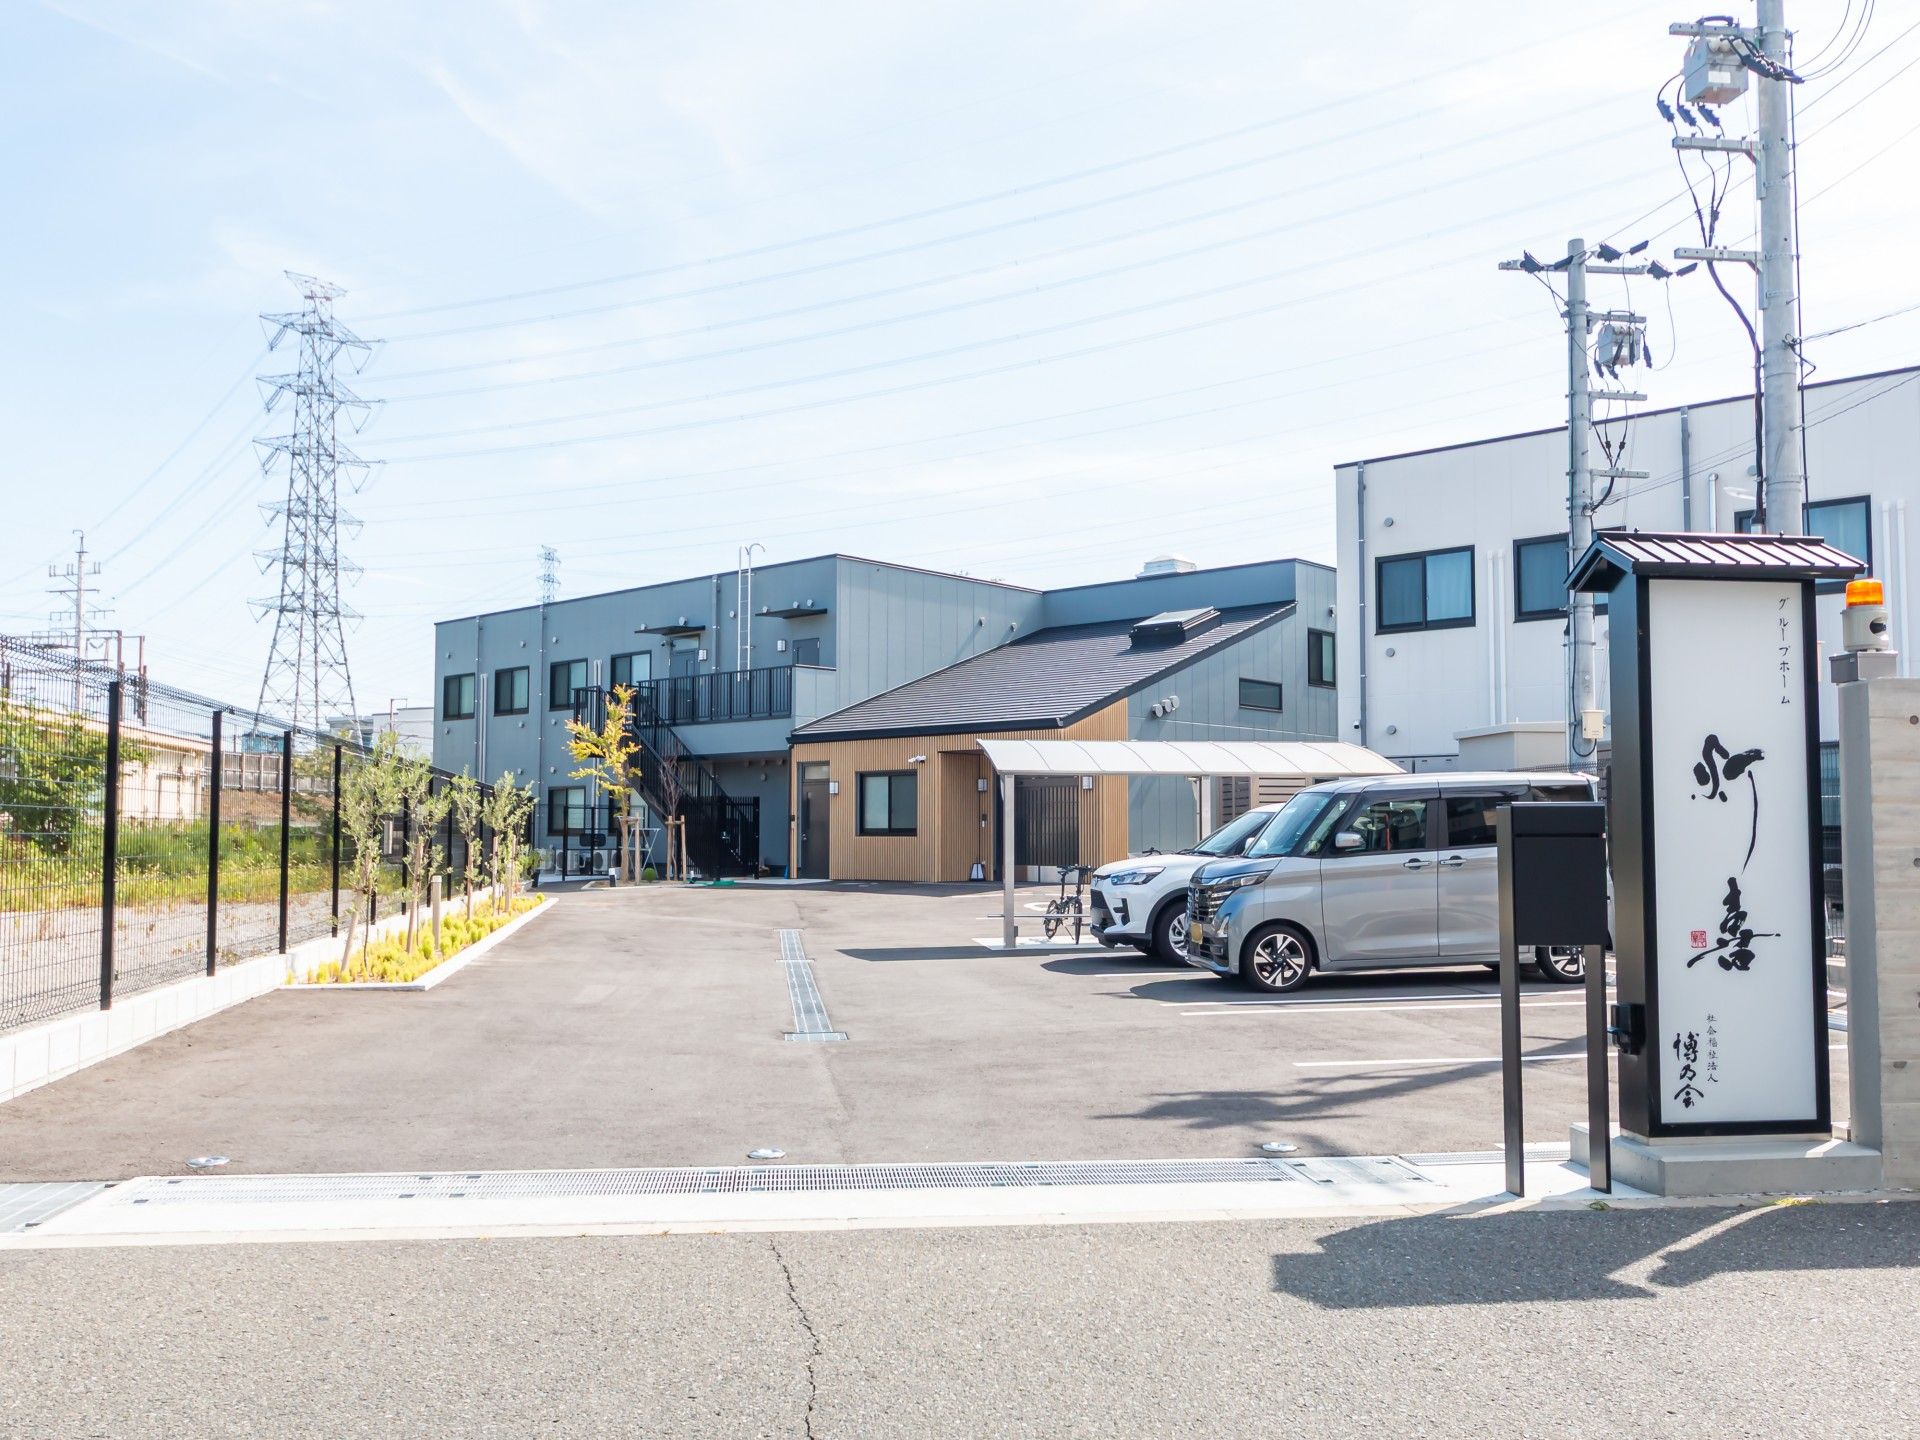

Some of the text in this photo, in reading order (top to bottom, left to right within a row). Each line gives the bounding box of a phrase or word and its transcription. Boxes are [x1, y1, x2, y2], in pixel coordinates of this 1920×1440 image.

[1778, 596, 1791, 705] グループホーム
[1706, 1013, 1719, 1083] 社会福祉法人
